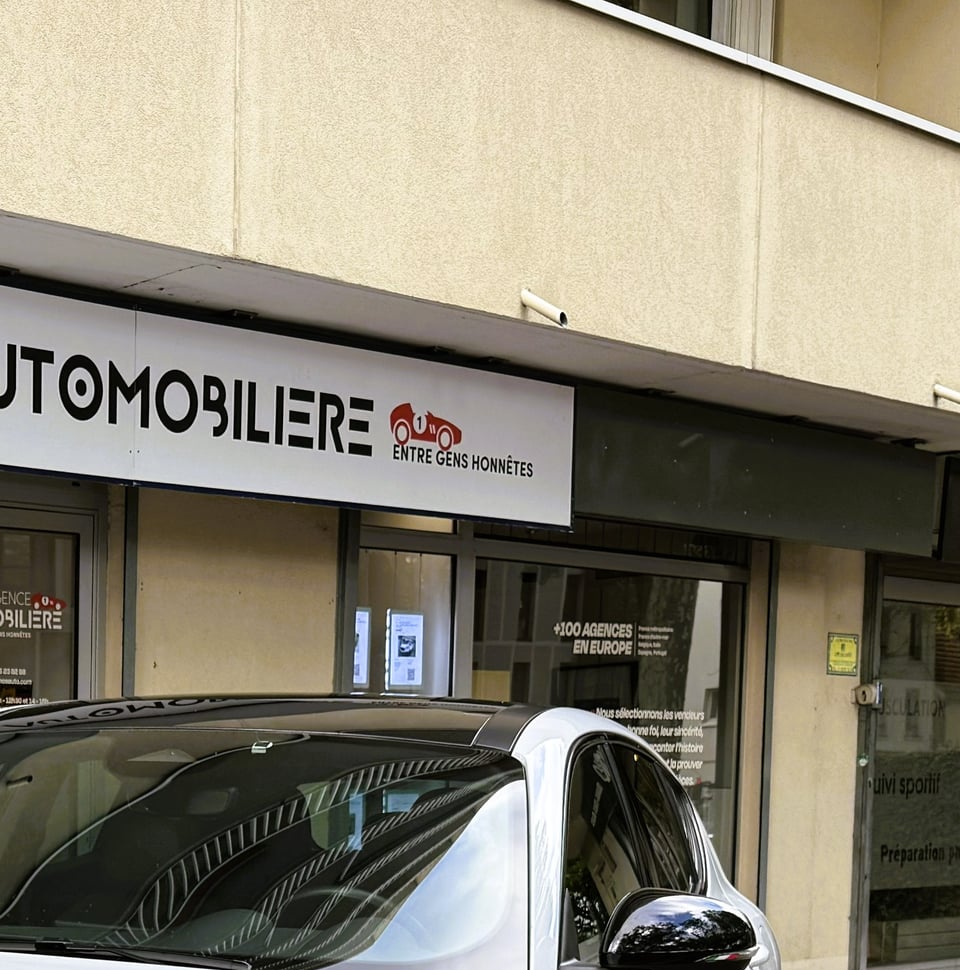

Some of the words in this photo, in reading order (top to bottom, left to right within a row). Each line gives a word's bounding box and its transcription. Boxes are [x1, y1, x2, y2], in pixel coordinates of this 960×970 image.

[416, 415, 423, 431] 1
[392, 444, 433, 464] ENTRE
[435, 450, 469, 469] GENS
[471, 455, 534, 478] HONNÊTES
[553, 621, 582, 637] +100
[581, 622, 634, 638] AGENCES
[572, 639, 590, 655] EN
[589, 640, 634, 656] EUROPE
[595, 707, 615, 719] Nous
[614, 707, 663, 720] sélectionnons
[663, 710, 675, 720] les
[674, 710, 705, 721] vendeurs
[648, 724, 660, 738] foi,
[659, 725, 674, 737] leur
[674, 741, 704, 753] l'histoire
[676, 760, 703, 771] prouver
[899, 772, 942, 800] sportif
[879, 842, 946, 868] Préparation
